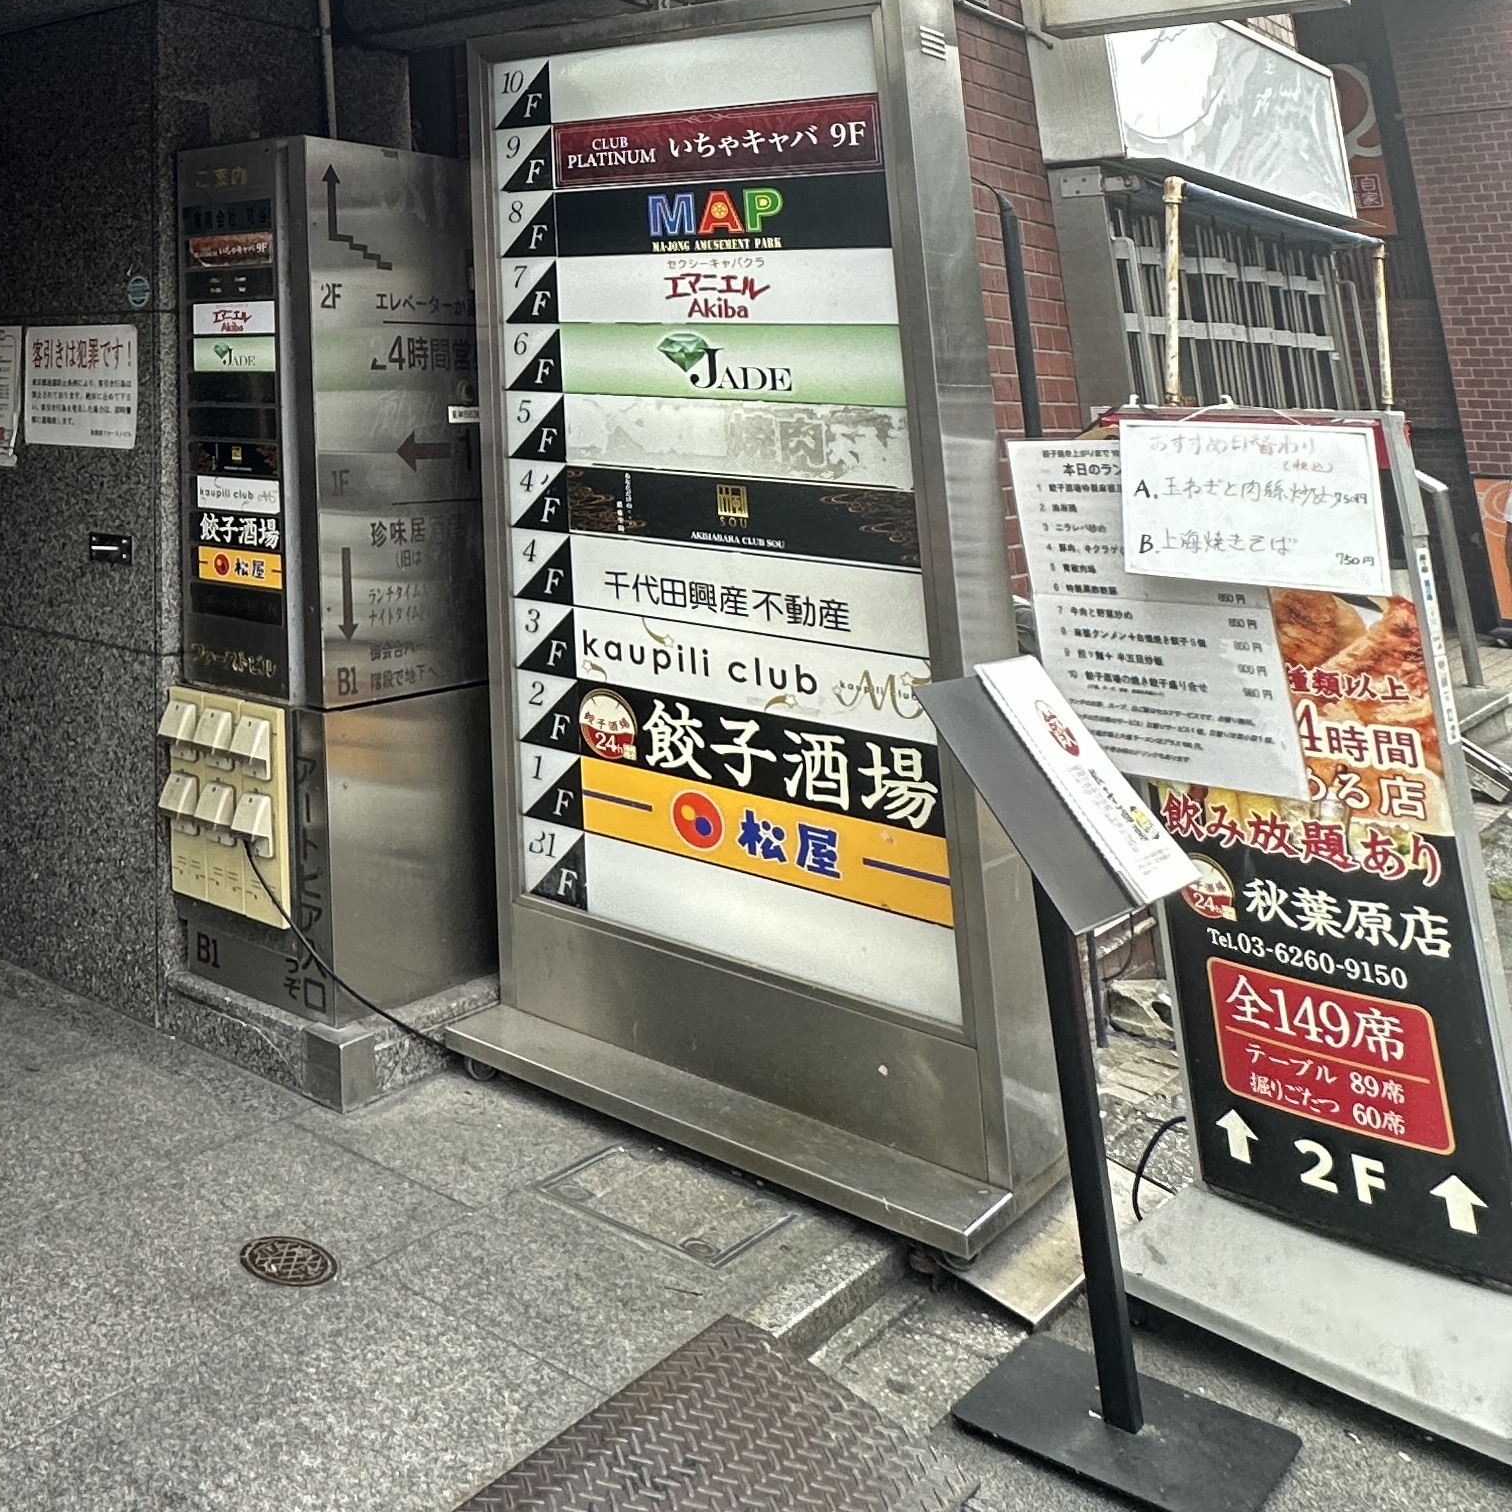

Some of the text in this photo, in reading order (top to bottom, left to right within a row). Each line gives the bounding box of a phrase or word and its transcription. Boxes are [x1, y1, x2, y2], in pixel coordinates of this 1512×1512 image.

[567, 147, 657, 169] PLATINUM
[591, 135, 629, 151] CLUB
[669, 121, 867, 160] いちゃキャバ 9F
[647, 187, 784, 237] MAP
[664, 272, 771, 301] エマニエル
[687, 297, 750, 320] Akiba
[223, 346, 257, 368] JADE
[689, 347, 794, 393] JADE
[198, 512, 281, 551] 餃子酒場
[719, 515, 749, 530] SOU
[234, 557, 266, 580] 松屋
[603, 569, 853, 635] 千代田興産不動産
[582, 629, 819, 696] kaupili club
[642, 698, 940, 830] 餃子酒場
[738, 808, 843, 880] 松屋
[1160, 789, 1443, 887] 飲み放題あり
[1242, 877, 1453, 959] 秋葉原店
[197, 931, 221, 969] B1
[1207, 925, 1408, 990] Tel.03-6260-9150
[1224, 973, 1406, 1063] 全149席
[1244, 1042, 1407, 1106] テーブル 89席
[1249, 1071, 1407, 1138] 掘りごたつ 60席
[1292, 1137, 1387, 1206] 2F
